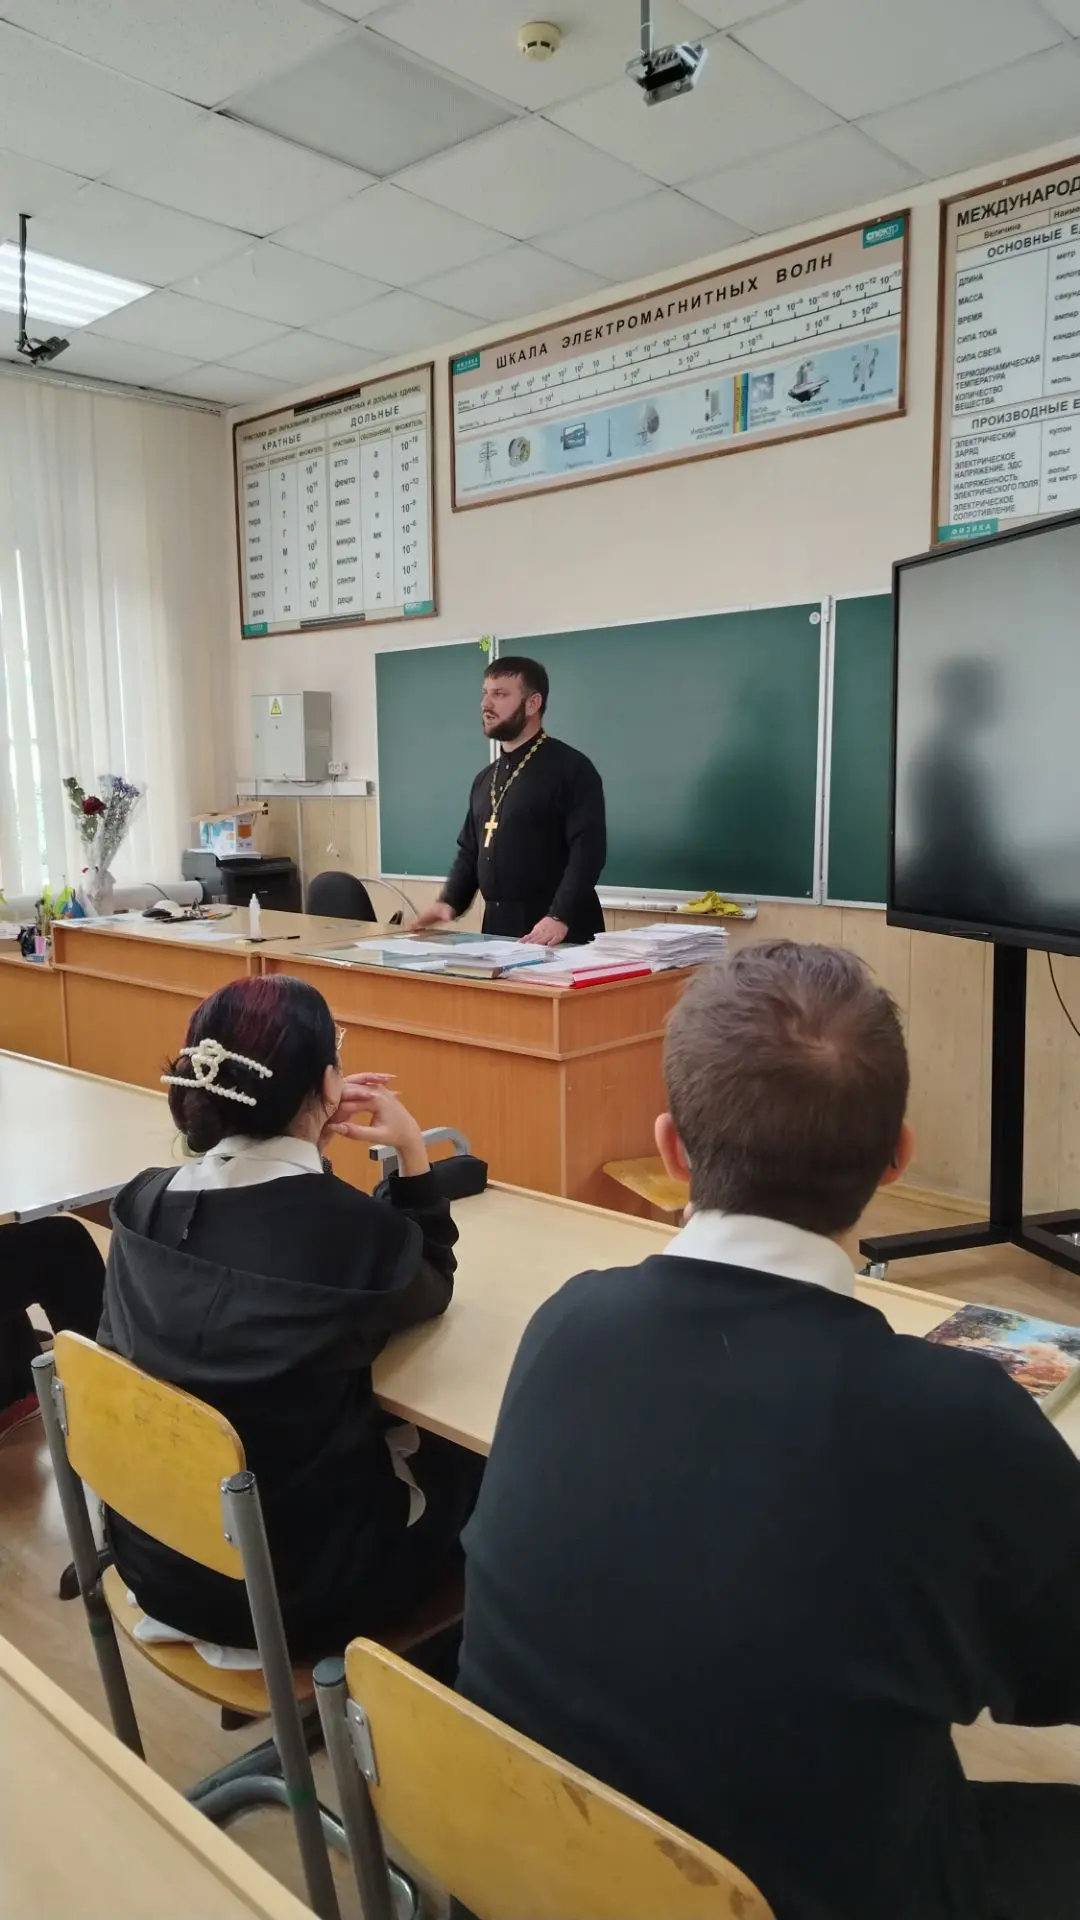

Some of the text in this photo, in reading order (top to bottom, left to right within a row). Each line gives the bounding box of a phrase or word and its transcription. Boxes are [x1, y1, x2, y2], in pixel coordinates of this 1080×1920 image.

[984, 224, 1021, 239] Величина
[987, 224, 1080, 258] ОСНОВНЫЕ Е
[958, 249, 1076, 287] ДЛИНА метр
[958, 292, 984, 306] МАССА
[496, 252, 832, 370] ШКАЛА ЭЛЕКТРОМАГНИТНЫХ ВОЛН
[958, 312, 982, 325] ВРЕМЯ
[958, 310, 1079, 344] СИЛА ТОКА ампер
[956, 354, 976, 364] СИЛА
[978, 346, 1002, 358] СВЕТА
[956, 354, 1040, 380] ТЕРМОДИНАМИЧЕСКАЯ
[956, 372, 1006, 390] ТЕМПЕРАТУРА
[955, 385, 1003, 401] КОЛИЧЕСТВО
[955, 396, 995, 412] ВЕЩЕСТВА
[350, 405, 400, 428] ДОЛЬНЫЕ
[972, 400, 1068, 429] ПРОИЗВОДНЫЕ
[262, 434, 302, 452] КРАТНЫЕ
[956, 430, 1016, 448] ЭЛЕКТРИЧЕСКИЙ
[955, 447, 979, 458] ЗАРЯД
[955, 452, 1016, 470] ЭЛЕКТРИЧЕСКОЕ
[1008, 461, 1022, 470] ЭДС
[954, 474, 1018, 490] НАПРЯЖЕННОСТЬ
[954, 482, 1016, 500] ЭЛЕКТРИЧЕСКОГО
[1018, 480, 1038, 489] ПОЛЯ
[953, 504, 1016, 520] СОПРОТИВЛЕНИЕ
[954, 495, 1014, 512] ЭЛЕКТРИЧЕСКОЕ
[952, 524, 991, 535] ФИЗИКА
[336, 536, 356, 547] микро
